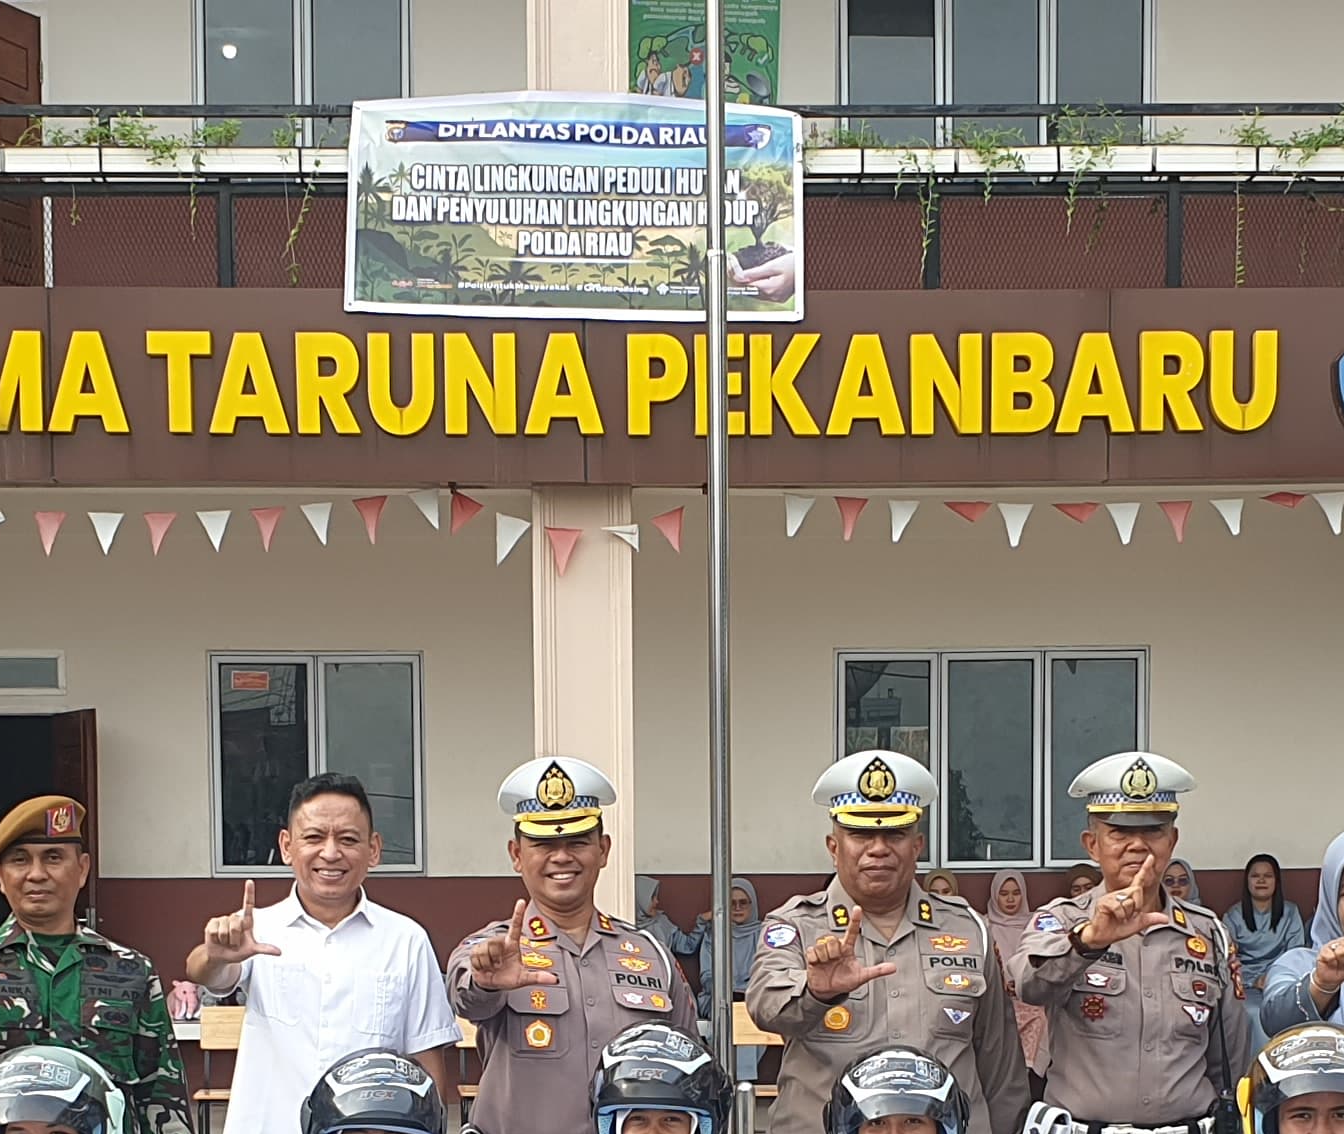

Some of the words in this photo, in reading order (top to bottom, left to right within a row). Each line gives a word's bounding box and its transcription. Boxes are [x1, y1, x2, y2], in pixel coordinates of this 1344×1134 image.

[438, 122, 570, 140] DITLANTAS
[574, 124, 655, 145] POLDA
[410, 164, 471, 192] CINTA
[473, 164, 600, 194] LINGKUNGAN
[604, 166, 672, 195] PEDULI
[675, 168, 741, 196] HUN
[391, 195, 433, 222] DAN
[436, 196, 564, 225] PENYULUHAN
[567, 199, 694, 227] LINGKUNGAN
[697, 200, 760, 227] HDUP
[517, 230, 582, 256] POLDA
[585, 231, 633, 257] RIAU
[146, 330, 606, 436] TARUNA
[626, 329, 1279, 437] PEKANBARU
[929, 957, 977, 969] POLRI
[615, 973, 662, 989] POLRI
